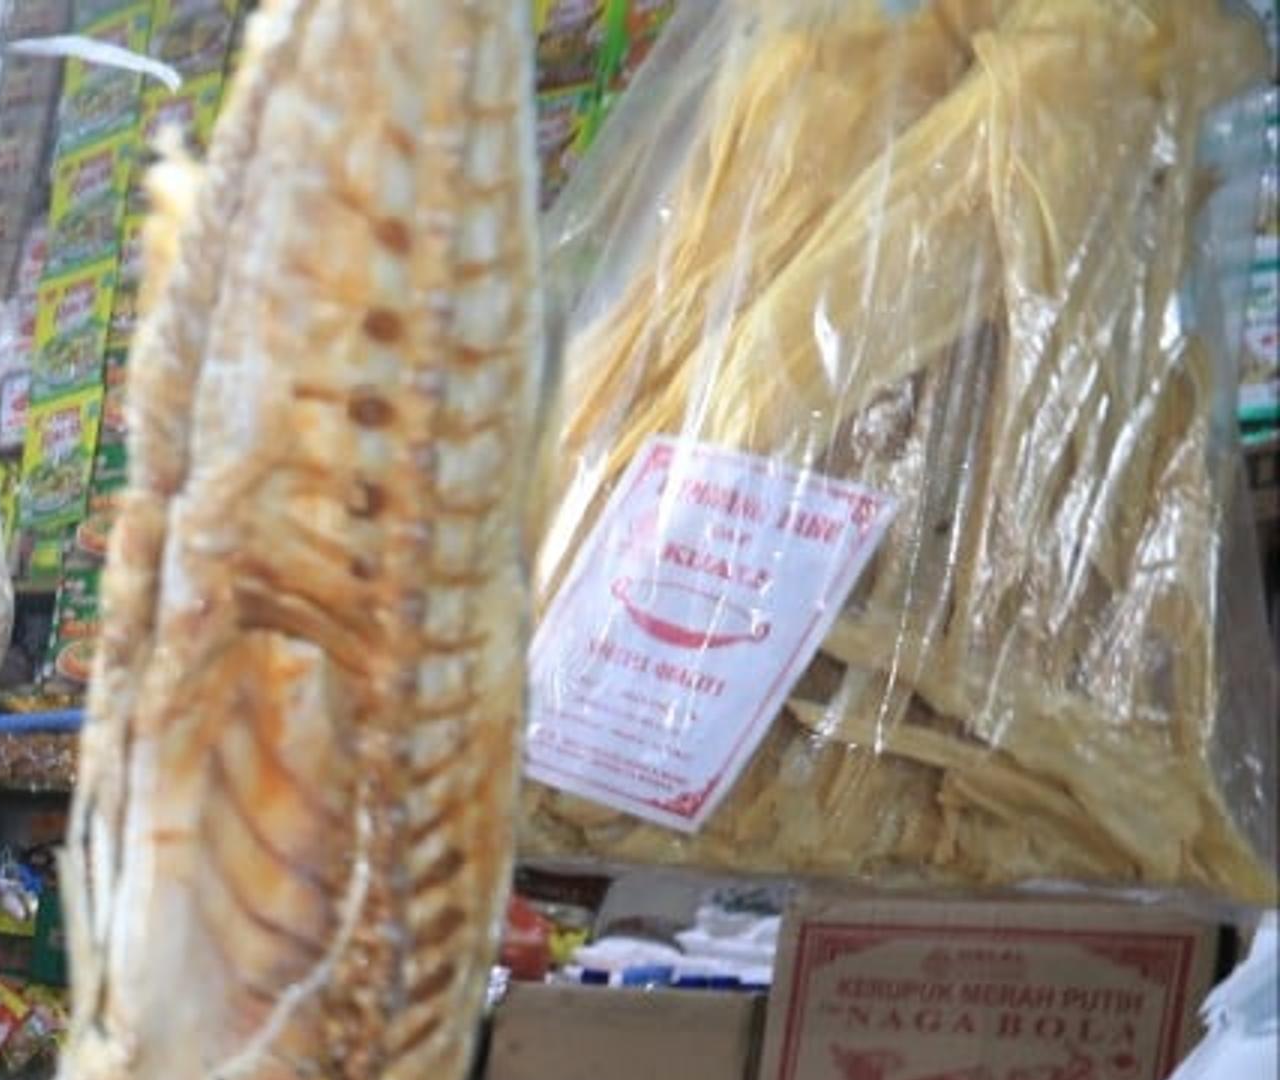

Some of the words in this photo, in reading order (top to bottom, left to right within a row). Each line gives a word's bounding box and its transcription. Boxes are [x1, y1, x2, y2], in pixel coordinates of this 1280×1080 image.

[837, 978, 953, 1004] KERUPUK
[959, 982, 1057, 1010] MERAH
[1062, 988, 1146, 1016] PUTIH
[846, 1006, 975, 1034] NAGA
[996, 1012, 1140, 1044] BOLA
